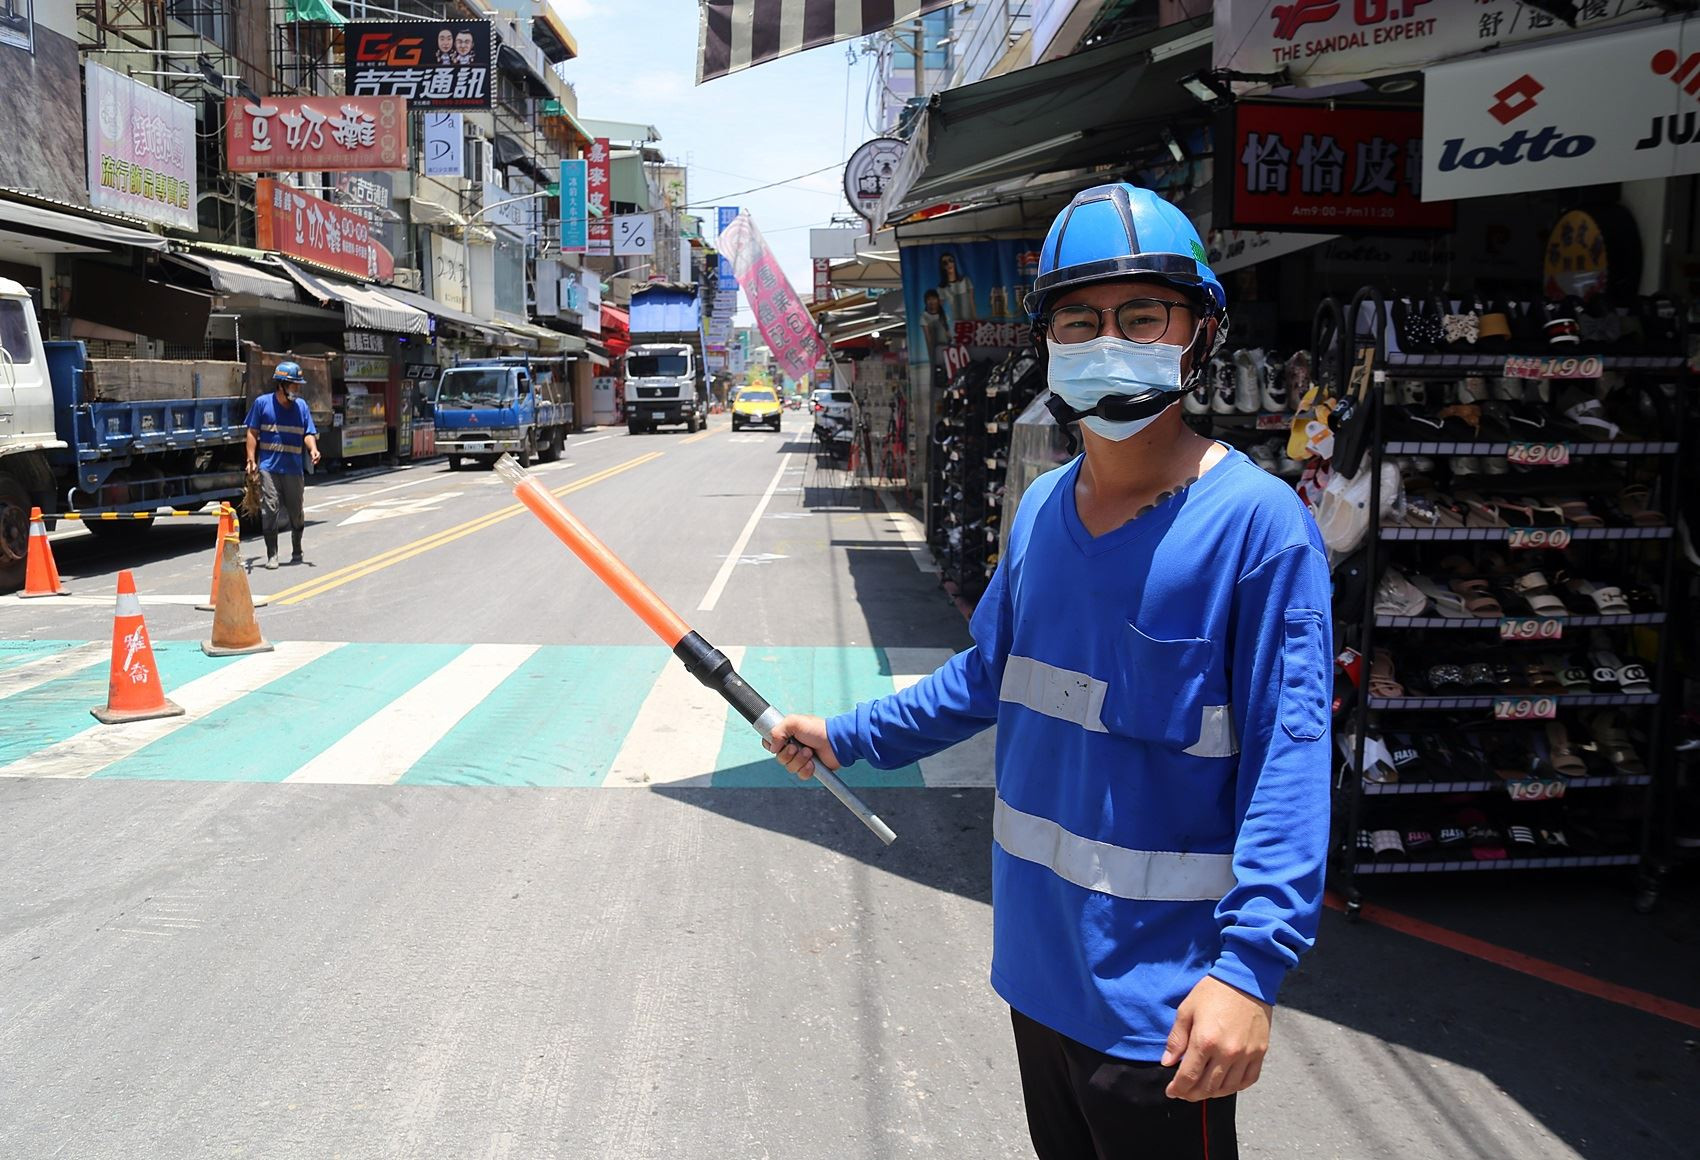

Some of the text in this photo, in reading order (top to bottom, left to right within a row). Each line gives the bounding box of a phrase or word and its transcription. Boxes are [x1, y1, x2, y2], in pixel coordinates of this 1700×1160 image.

[1478, 13, 1504, 39] 舒
[1272, 18, 1437, 64] THE SANDAL EXPERT
[354, 67, 486, 99] 吉吉通訊
[244, 104, 376, 152] 豆奶攤
[1438, 125, 1597, 173] lotto
[100, 153, 190, 211] 流行飾品專賣店
[1542, 357, 1596, 377] 190
[1508, 444, 1565, 463] 190
[1510, 529, 1568, 547] 190
[1503, 619, 1558, 638] 190
[1500, 699, 1552, 718] 190
[1511, 782, 1563, 799] 190
